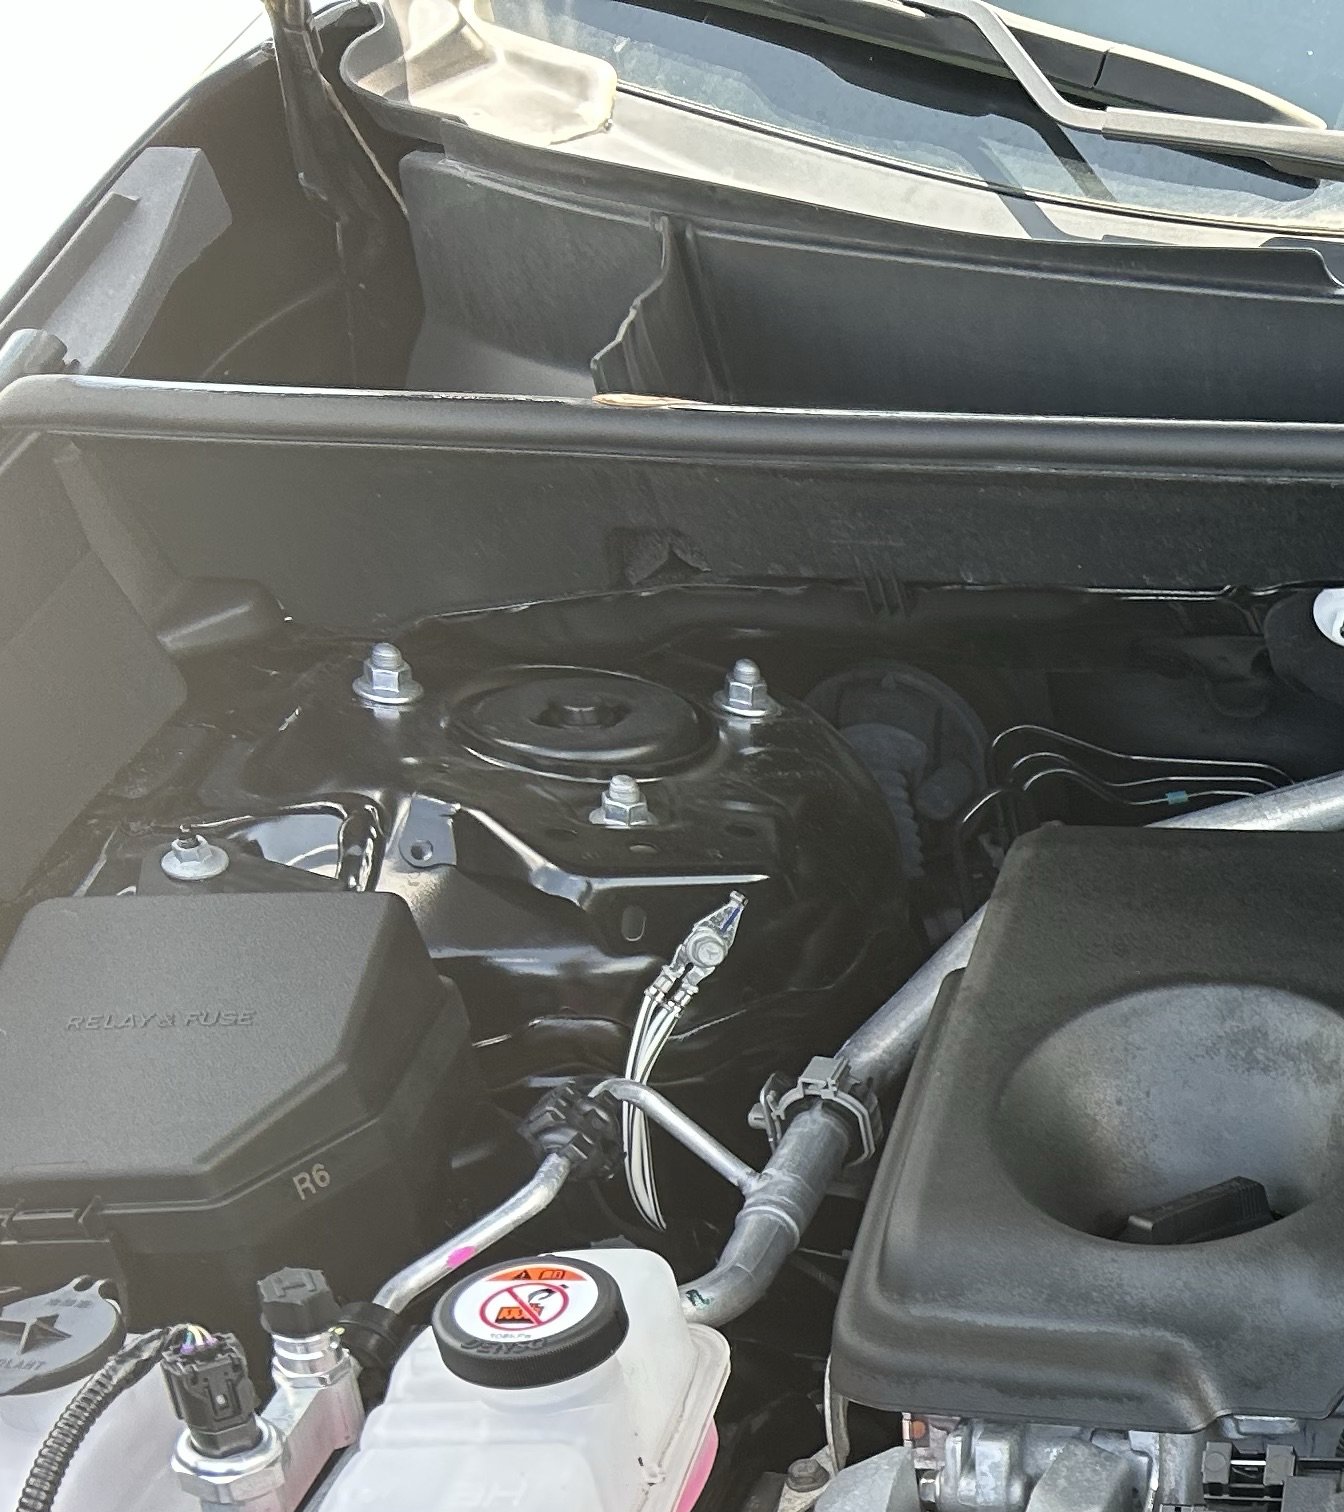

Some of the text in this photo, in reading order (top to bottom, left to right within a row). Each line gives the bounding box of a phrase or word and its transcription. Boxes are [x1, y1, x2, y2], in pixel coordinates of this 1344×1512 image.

[66, 1013, 157, 1031] RELAY
[184, 1009, 258, 1027] FUSE
[292, 1163, 330, 1201] R6
